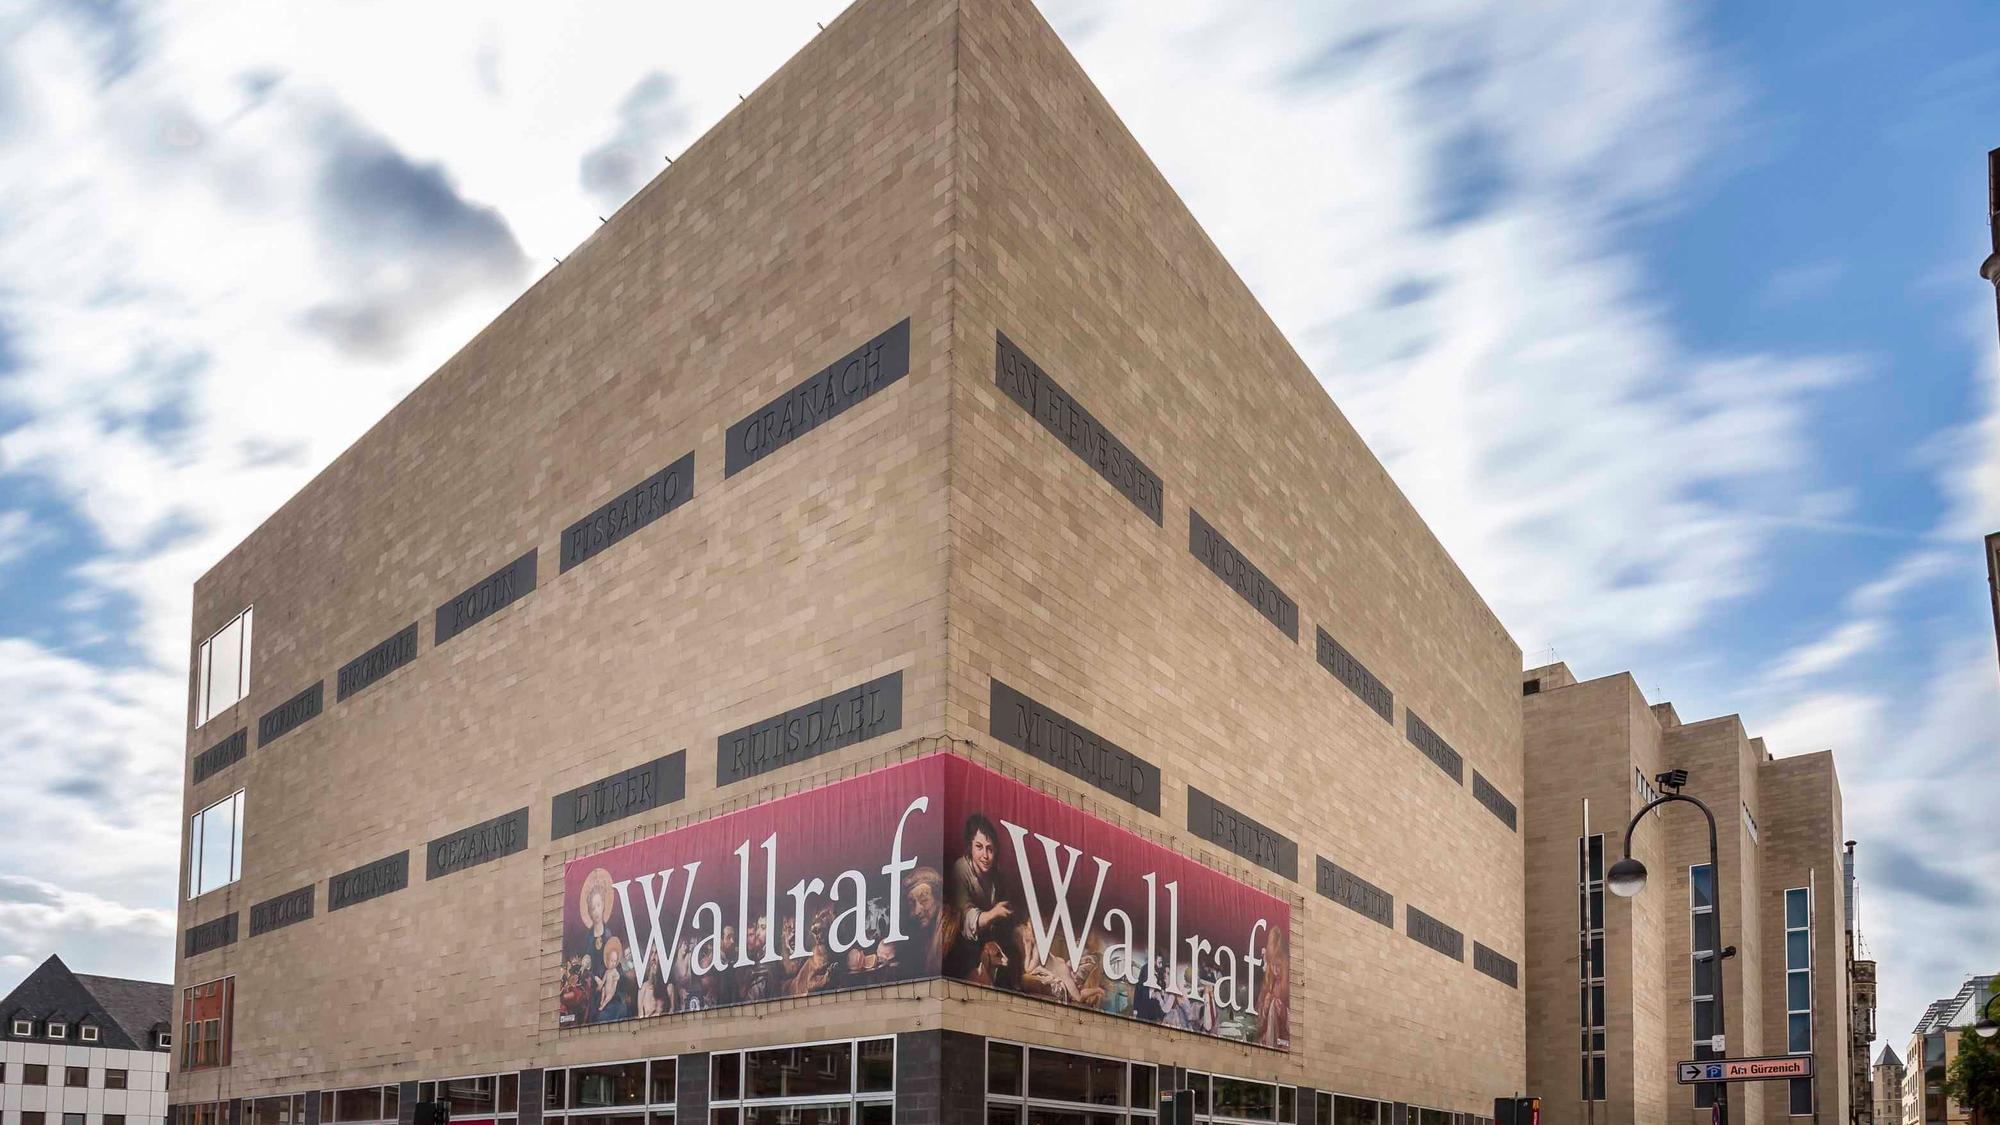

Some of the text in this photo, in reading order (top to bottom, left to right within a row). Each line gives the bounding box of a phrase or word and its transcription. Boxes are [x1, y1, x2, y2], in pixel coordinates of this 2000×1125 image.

[743, 342, 886, 454] CRANACH
[997, 341, 1164, 513] VAN HEMESSEN
[570, 471, 679, 560] PISSARRO
[453, 568, 516, 629] RODIN
[1202, 529, 1290, 626] MORISOT
[731, 689, 886, 773] RUISDAEL
[1013, 703, 1146, 796] MURILLO
[576, 770, 655, 825] DÜRER
[1213, 807, 1280, 867] BRUYN
[612, 796, 929, 989] Wallraf
[1000, 819, 1267, 1016] Wallraf
[1320, 865, 1391, 922] PIAZZETTA
[1730, 1065, 1747, 1075] Am
[1751, 1062, 1800, 1075] Gürzenich
